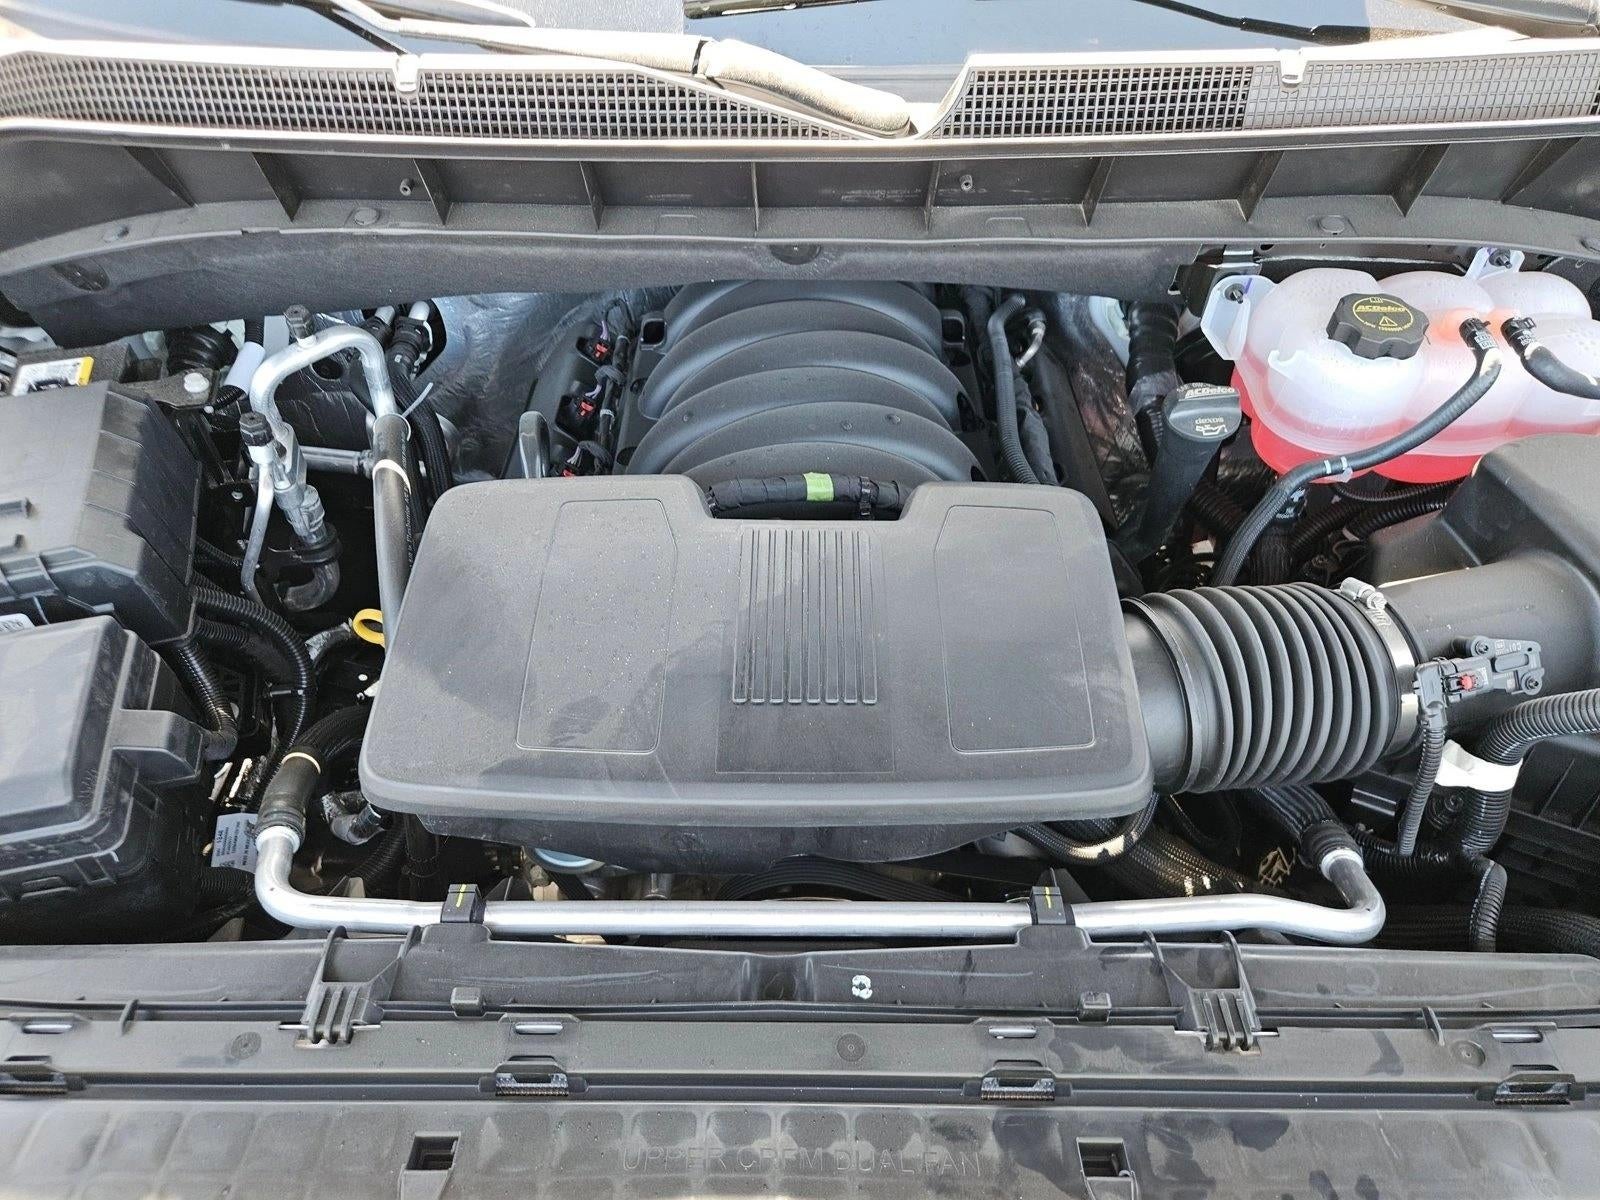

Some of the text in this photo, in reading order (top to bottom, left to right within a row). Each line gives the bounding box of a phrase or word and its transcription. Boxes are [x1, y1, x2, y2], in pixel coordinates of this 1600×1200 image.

[1355, 305, 1406, 313] ACDelco
[1184, 386, 1235, 398] ACDelco
[623, 1147, 727, 1171] UPPER
[836, 1149, 914, 1175] DUAL
[923, 1150, 980, 1177] FAN
